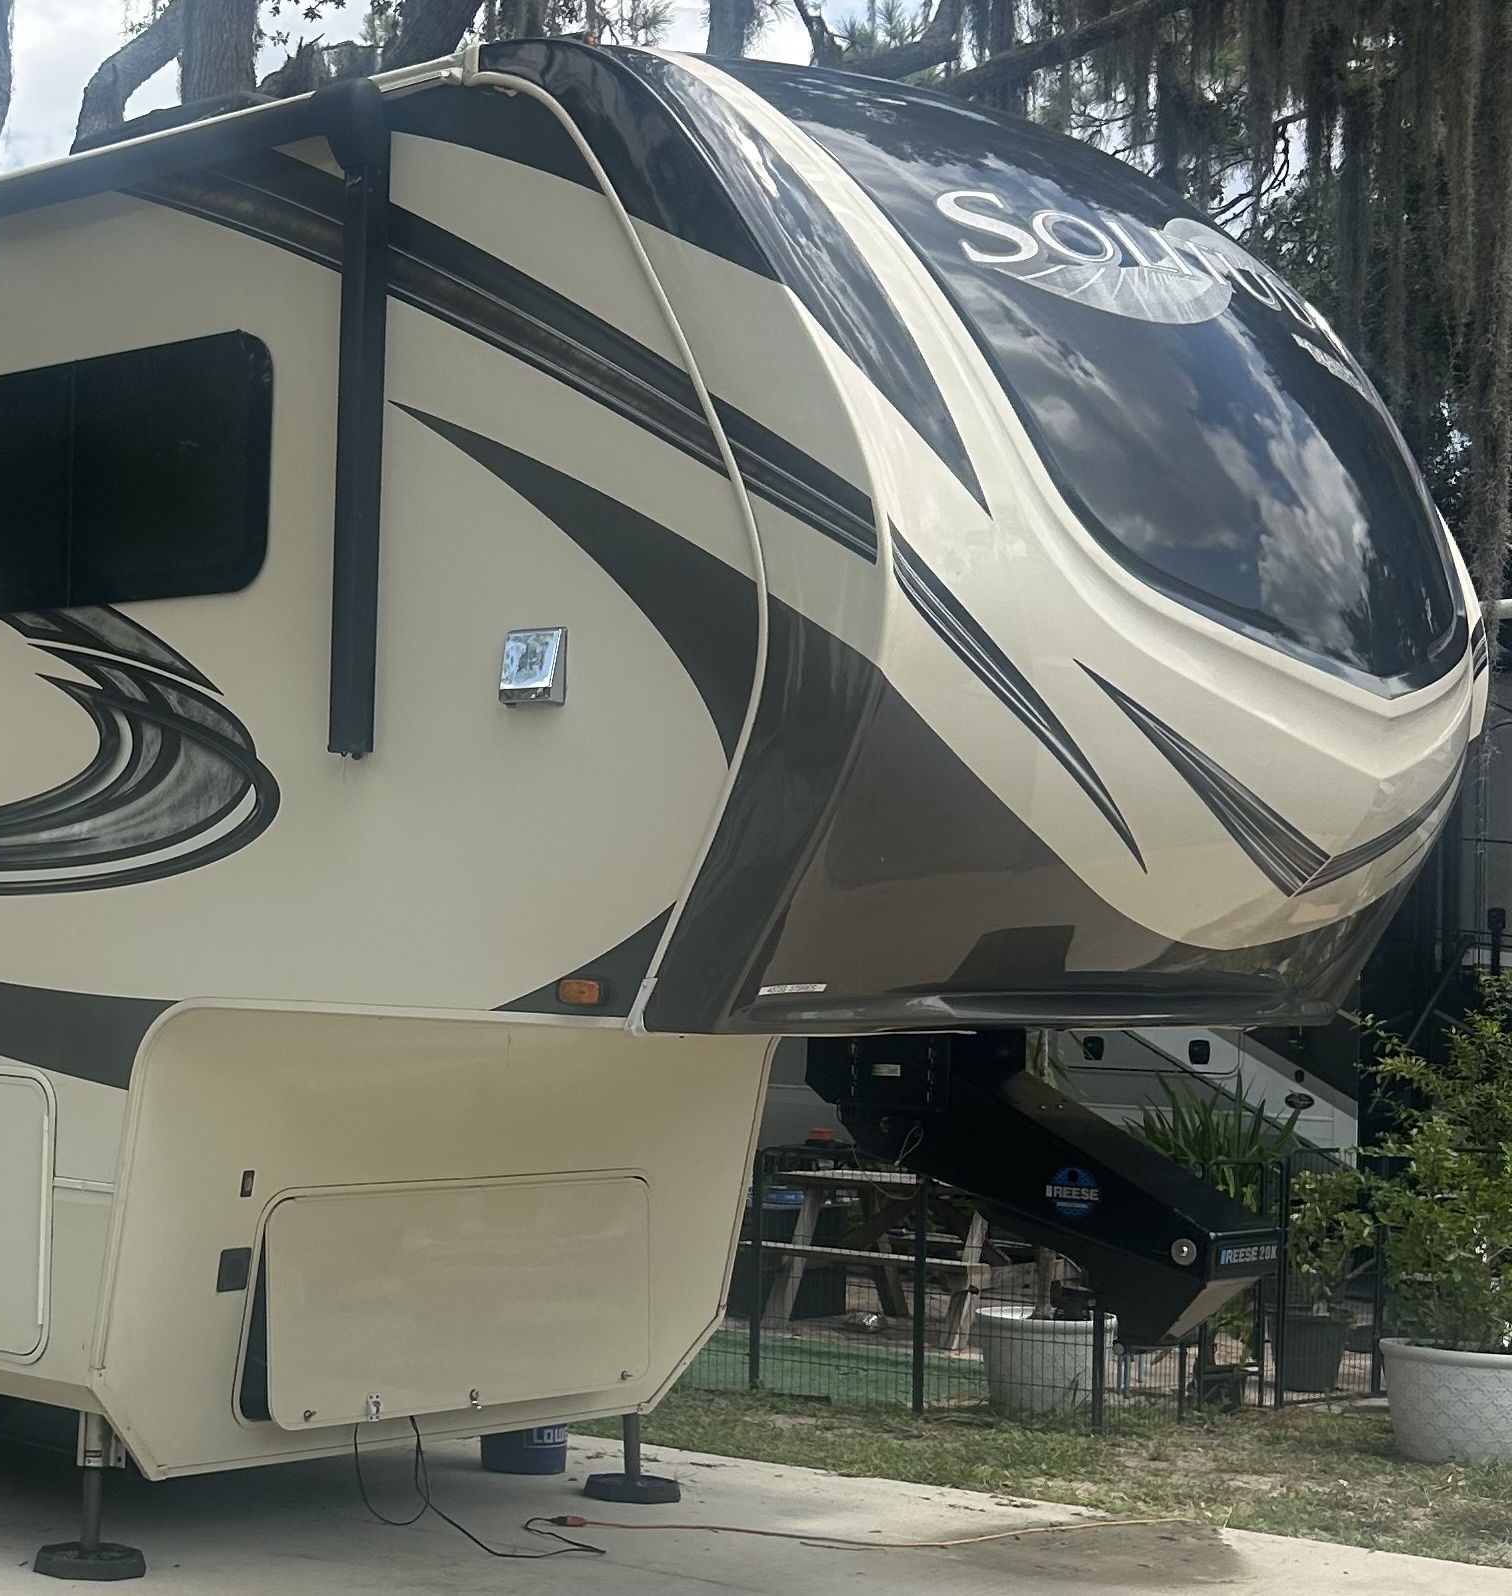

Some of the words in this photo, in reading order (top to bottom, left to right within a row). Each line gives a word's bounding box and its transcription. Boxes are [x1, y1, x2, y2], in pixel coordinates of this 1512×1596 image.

[936, 189, 1331, 337] SOLITUD
[1053, 1185, 1099, 1201] REESE
[1225, 1247, 1258, 1264] REESE
[1259, 1245, 1278, 1260] 20K
